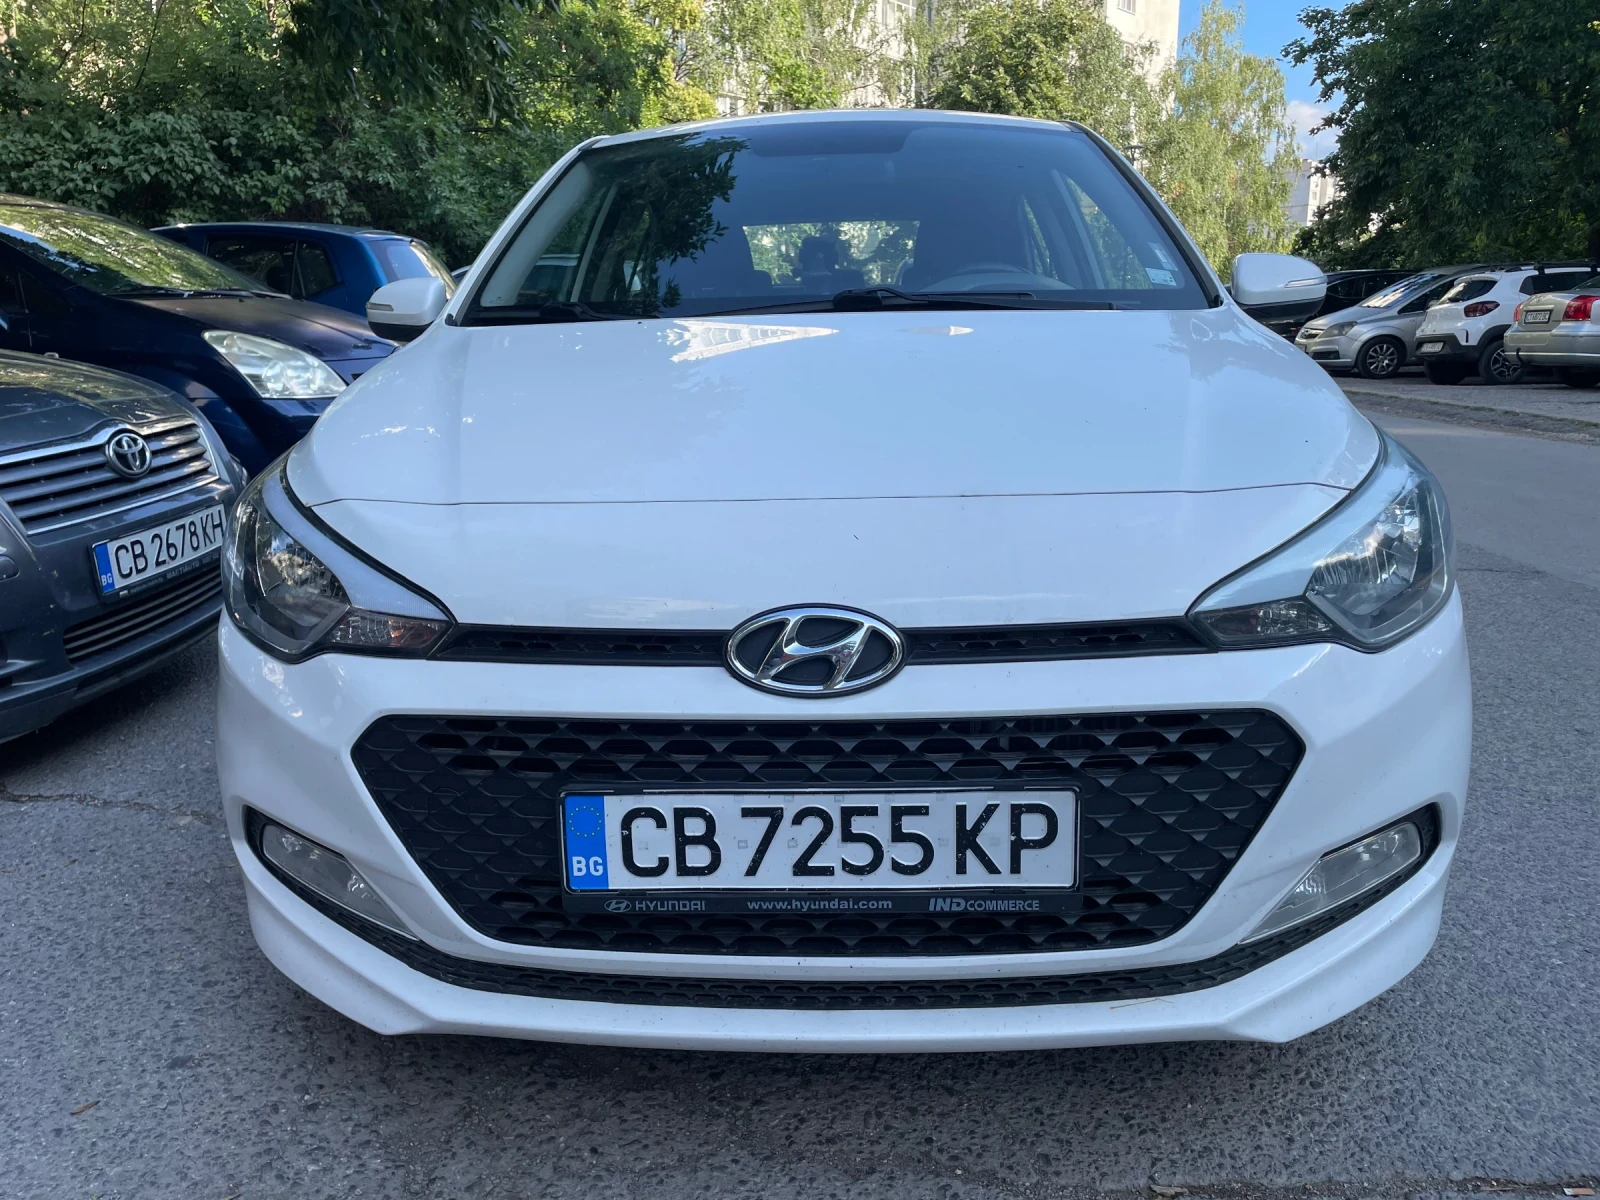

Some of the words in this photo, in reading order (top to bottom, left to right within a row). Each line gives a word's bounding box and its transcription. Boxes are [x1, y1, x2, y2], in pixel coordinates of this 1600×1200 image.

[101, 573, 113, 586] BG
[114, 539, 149, 579] CB
[150, 520, 200, 568] 2678
[200, 509, 224, 547] KH
[572, 856, 604, 877] BG
[620, 806, 722, 877] CB
[740, 804, 936, 877] 7255
[954, 802, 1060, 876] KP
[635, 900, 706, 911] HYUNDAI
[746, 898, 893, 911] www.hyundai.com
